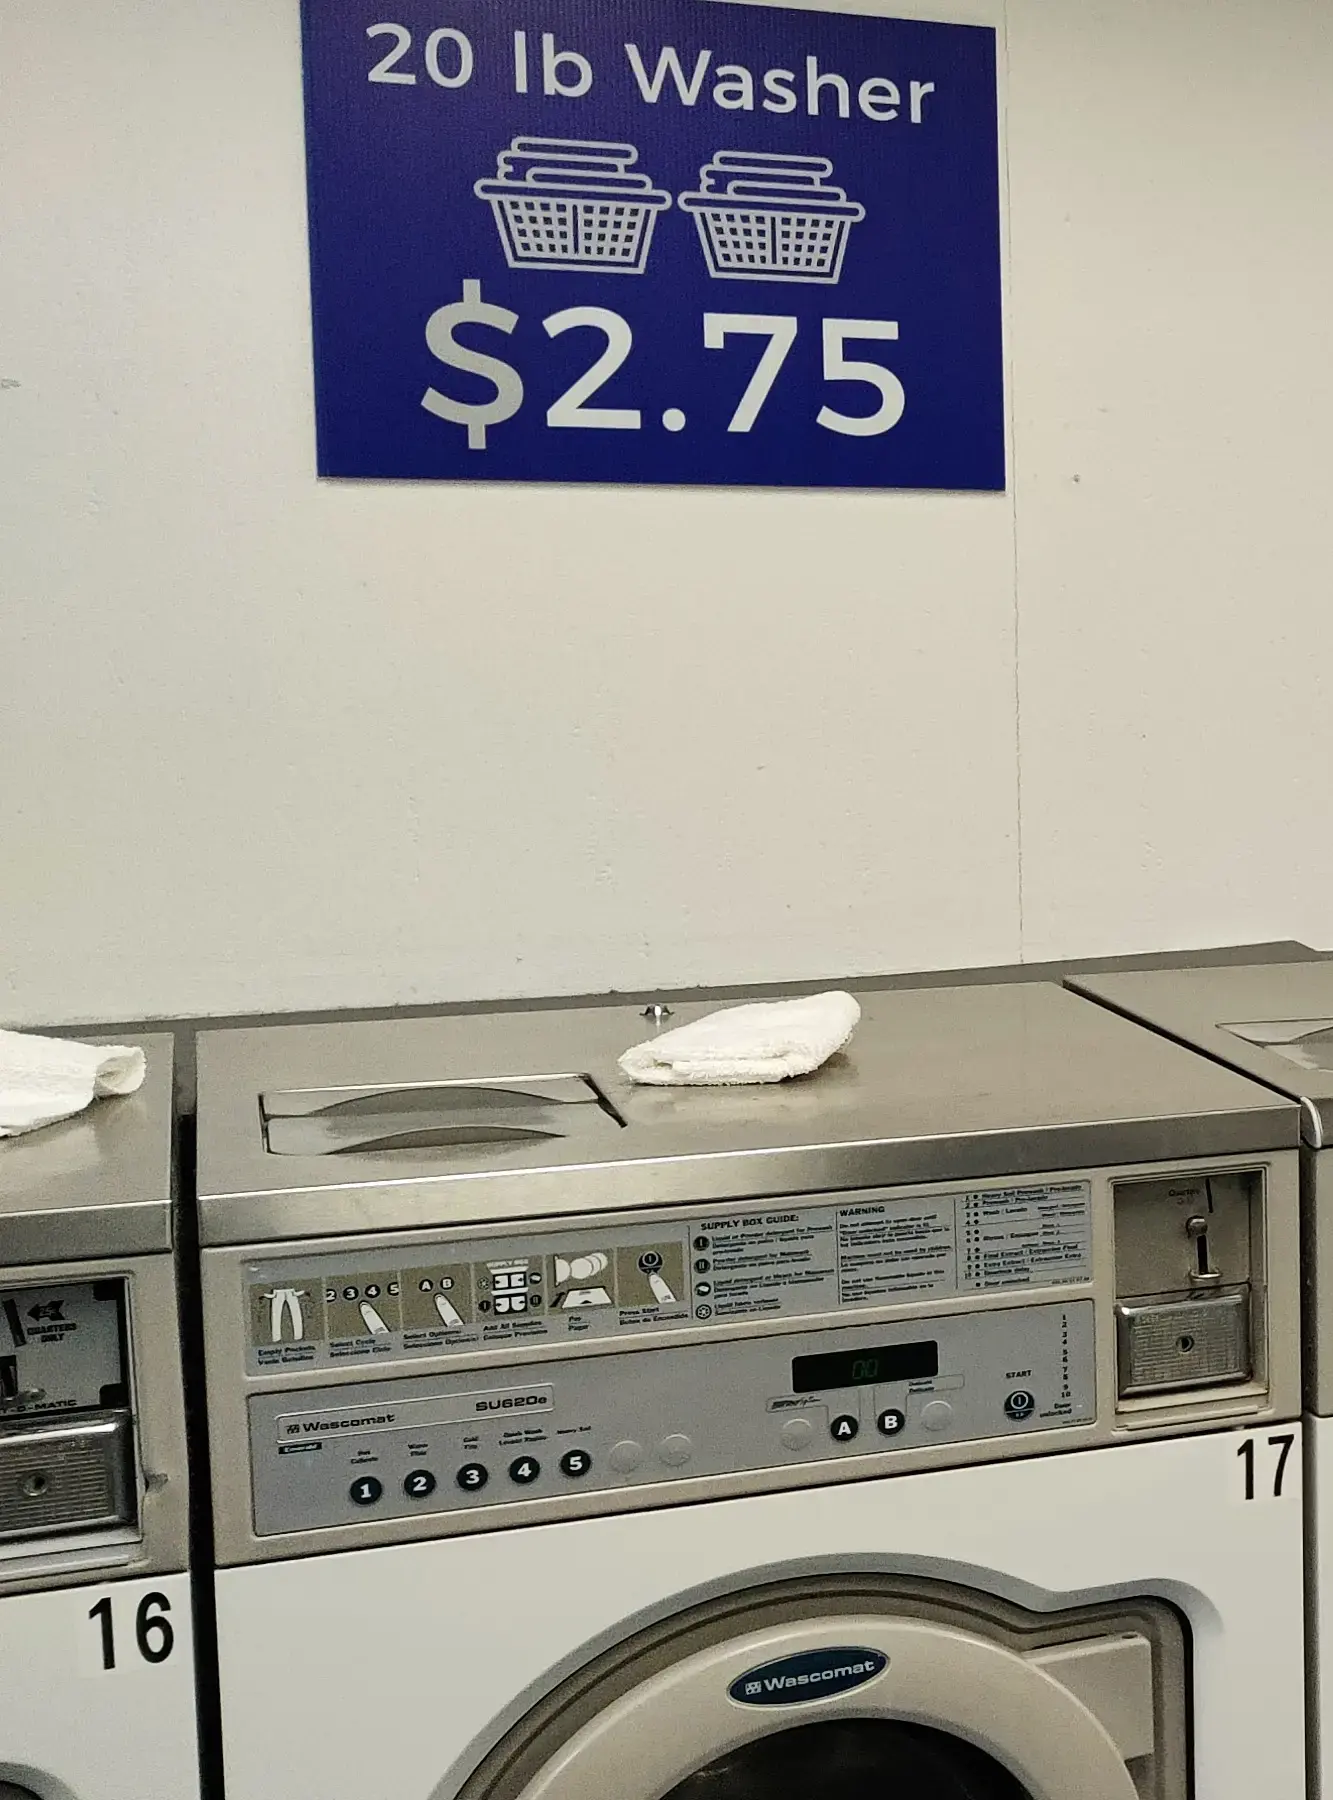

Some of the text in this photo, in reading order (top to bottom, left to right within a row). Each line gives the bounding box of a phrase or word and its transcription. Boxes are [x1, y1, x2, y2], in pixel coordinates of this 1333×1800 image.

[367, 23, 936, 125] 20 lb Washer
[420, 279, 906, 449] $2.75
[839, 1206, 885, 1217] WARNING
[701, 1214, 800, 1231] SUPPLY BOX GUIDE:
[1005, 1369, 1032, 1379] START
[303, 1414, 395, 1434] Wascomat
[837, 1421, 851, 1436] A
[884, 1415, 898, 1429] B
[517, 1462, 532, 1477] 4
[568, 1456, 582, 1470] 5
[1237, 1434, 1294, 1500] 17
[412, 1476, 427, 1491] 2
[465, 1469, 480, 1484] 3
[360, 1483, 372, 1498] 1
[87, 1592, 174, 1671] 16
[763, 1657, 876, 1692] Wascomat
